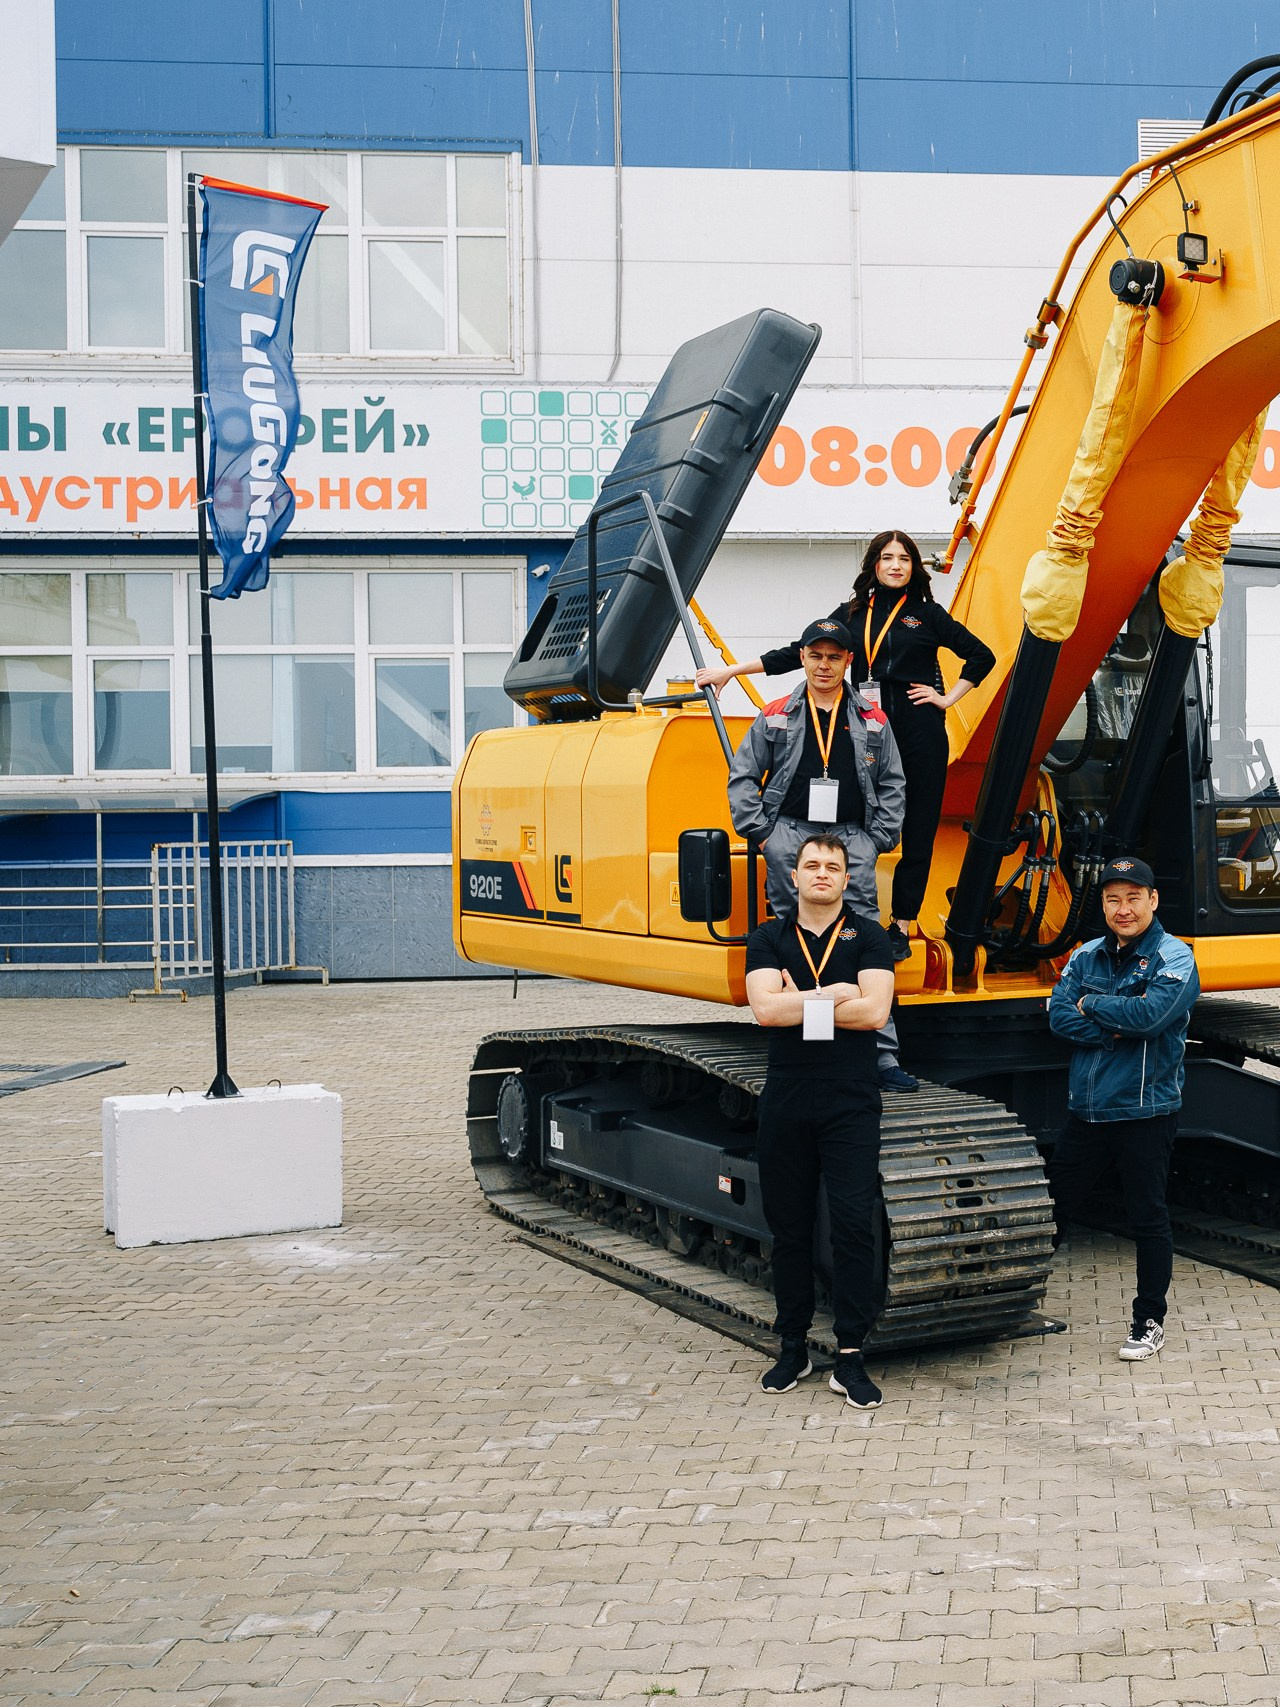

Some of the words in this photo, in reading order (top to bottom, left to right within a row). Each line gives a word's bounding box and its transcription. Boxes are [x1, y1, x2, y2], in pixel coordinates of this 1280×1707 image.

[0, 406, 66, 451] Ы
[756, 425, 997, 488] 08:00
[469, 874, 503, 900] 920E
